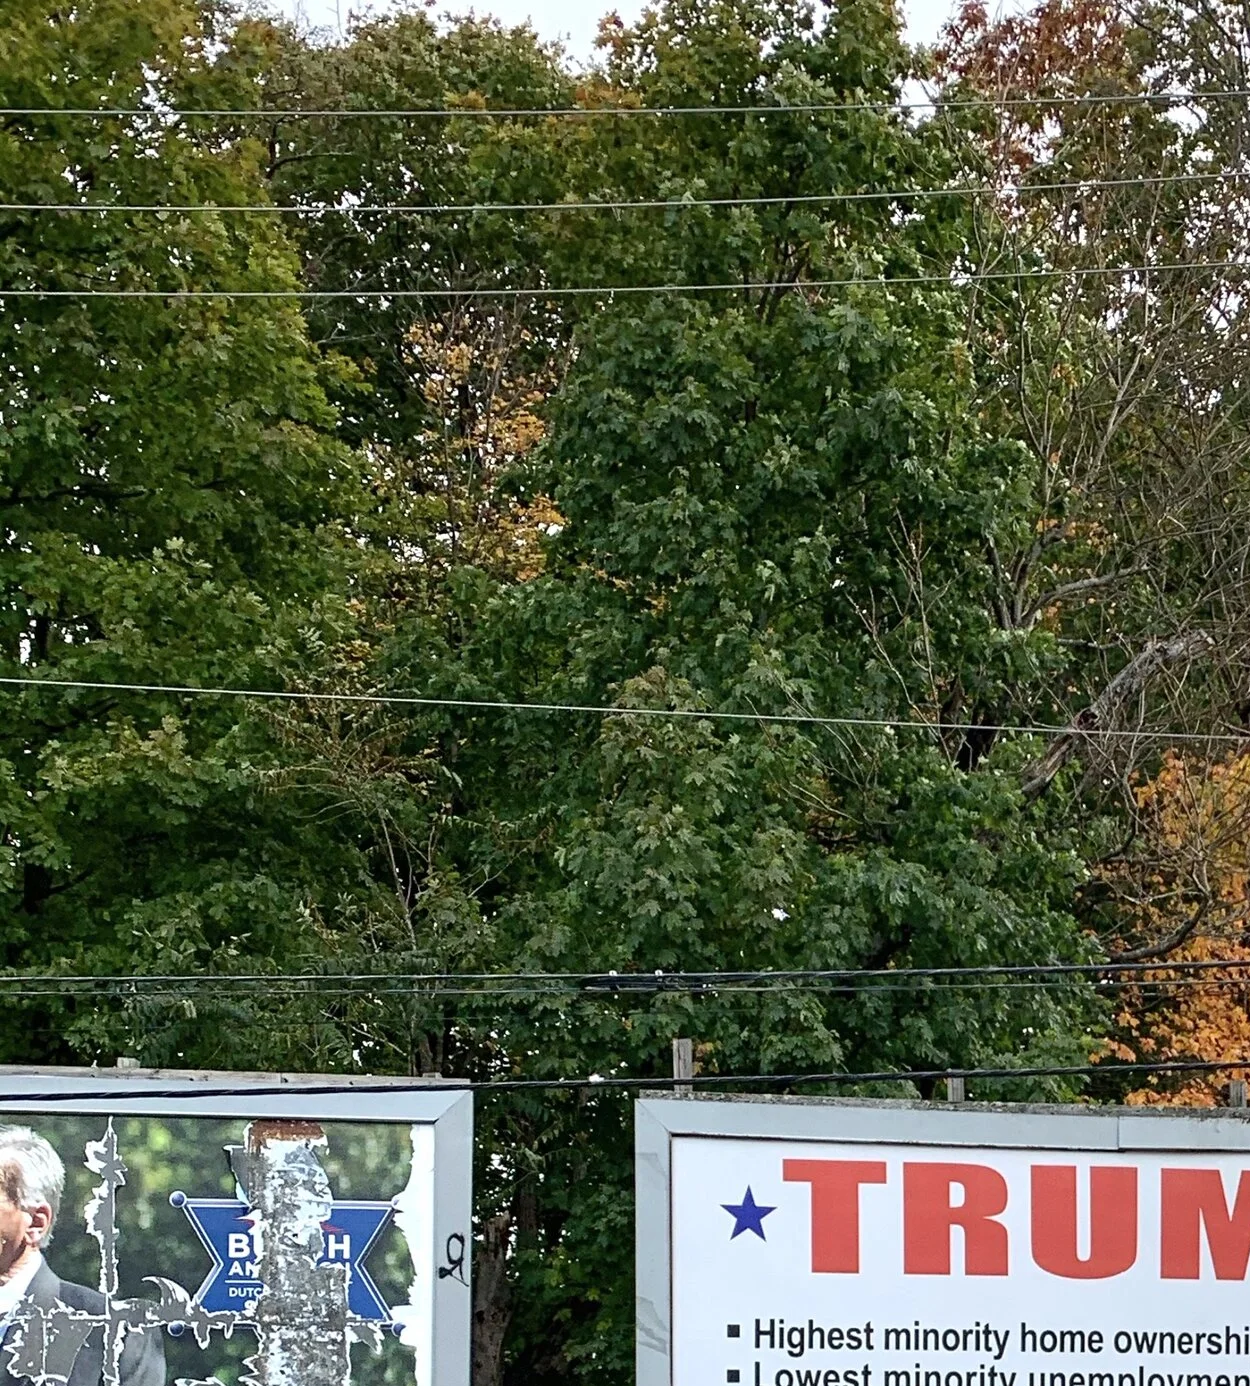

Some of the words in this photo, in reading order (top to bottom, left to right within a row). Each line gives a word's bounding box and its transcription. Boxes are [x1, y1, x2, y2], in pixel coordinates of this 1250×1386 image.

[754, 1318, 875, 1358] Highest
[884, 1320, 1011, 1361] minority
[1020, 1321, 1104, 1354] home
